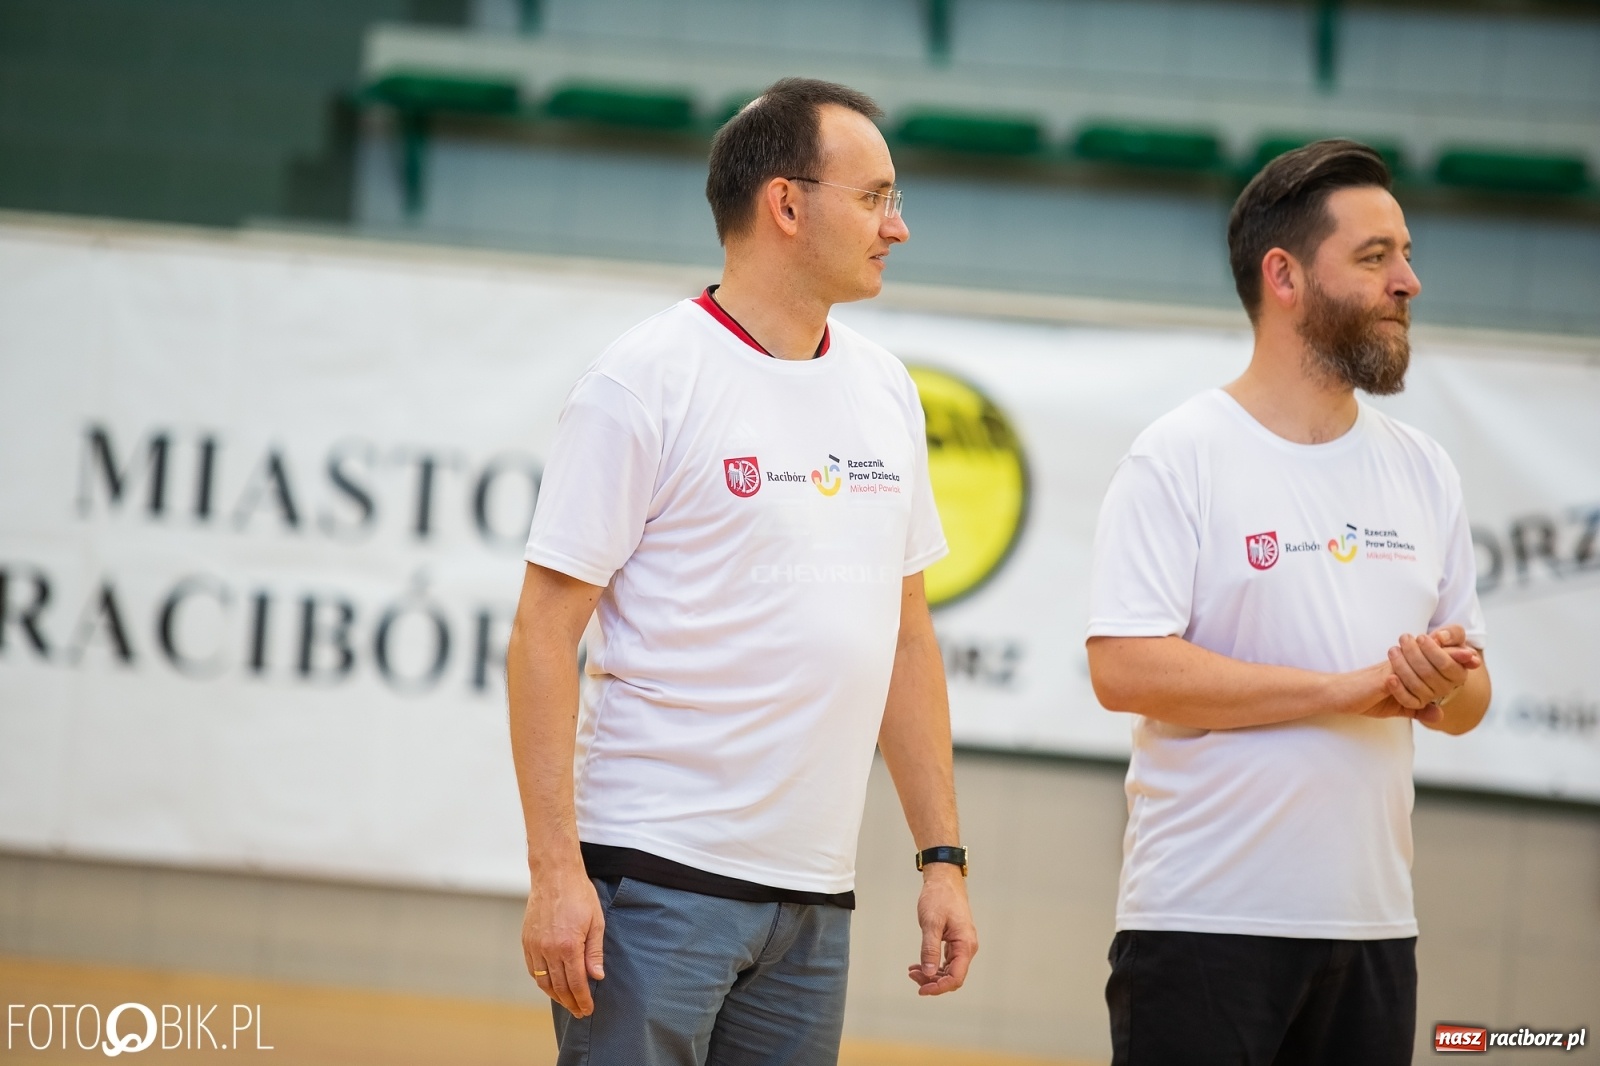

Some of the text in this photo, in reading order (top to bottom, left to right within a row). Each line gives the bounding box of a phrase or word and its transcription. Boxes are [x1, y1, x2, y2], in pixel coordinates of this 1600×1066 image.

[847, 459, 885, 468] Rzecznik
[766, 471, 807, 483] Racibórz
[849, 471, 900, 482] Praw Dziecka
[78, 419, 544, 549] MIASTO
[850, 484, 877, 494] Mikołaj
[1364, 529, 1398, 538] Rzecznik
[1365, 540, 1385, 548] Praw
